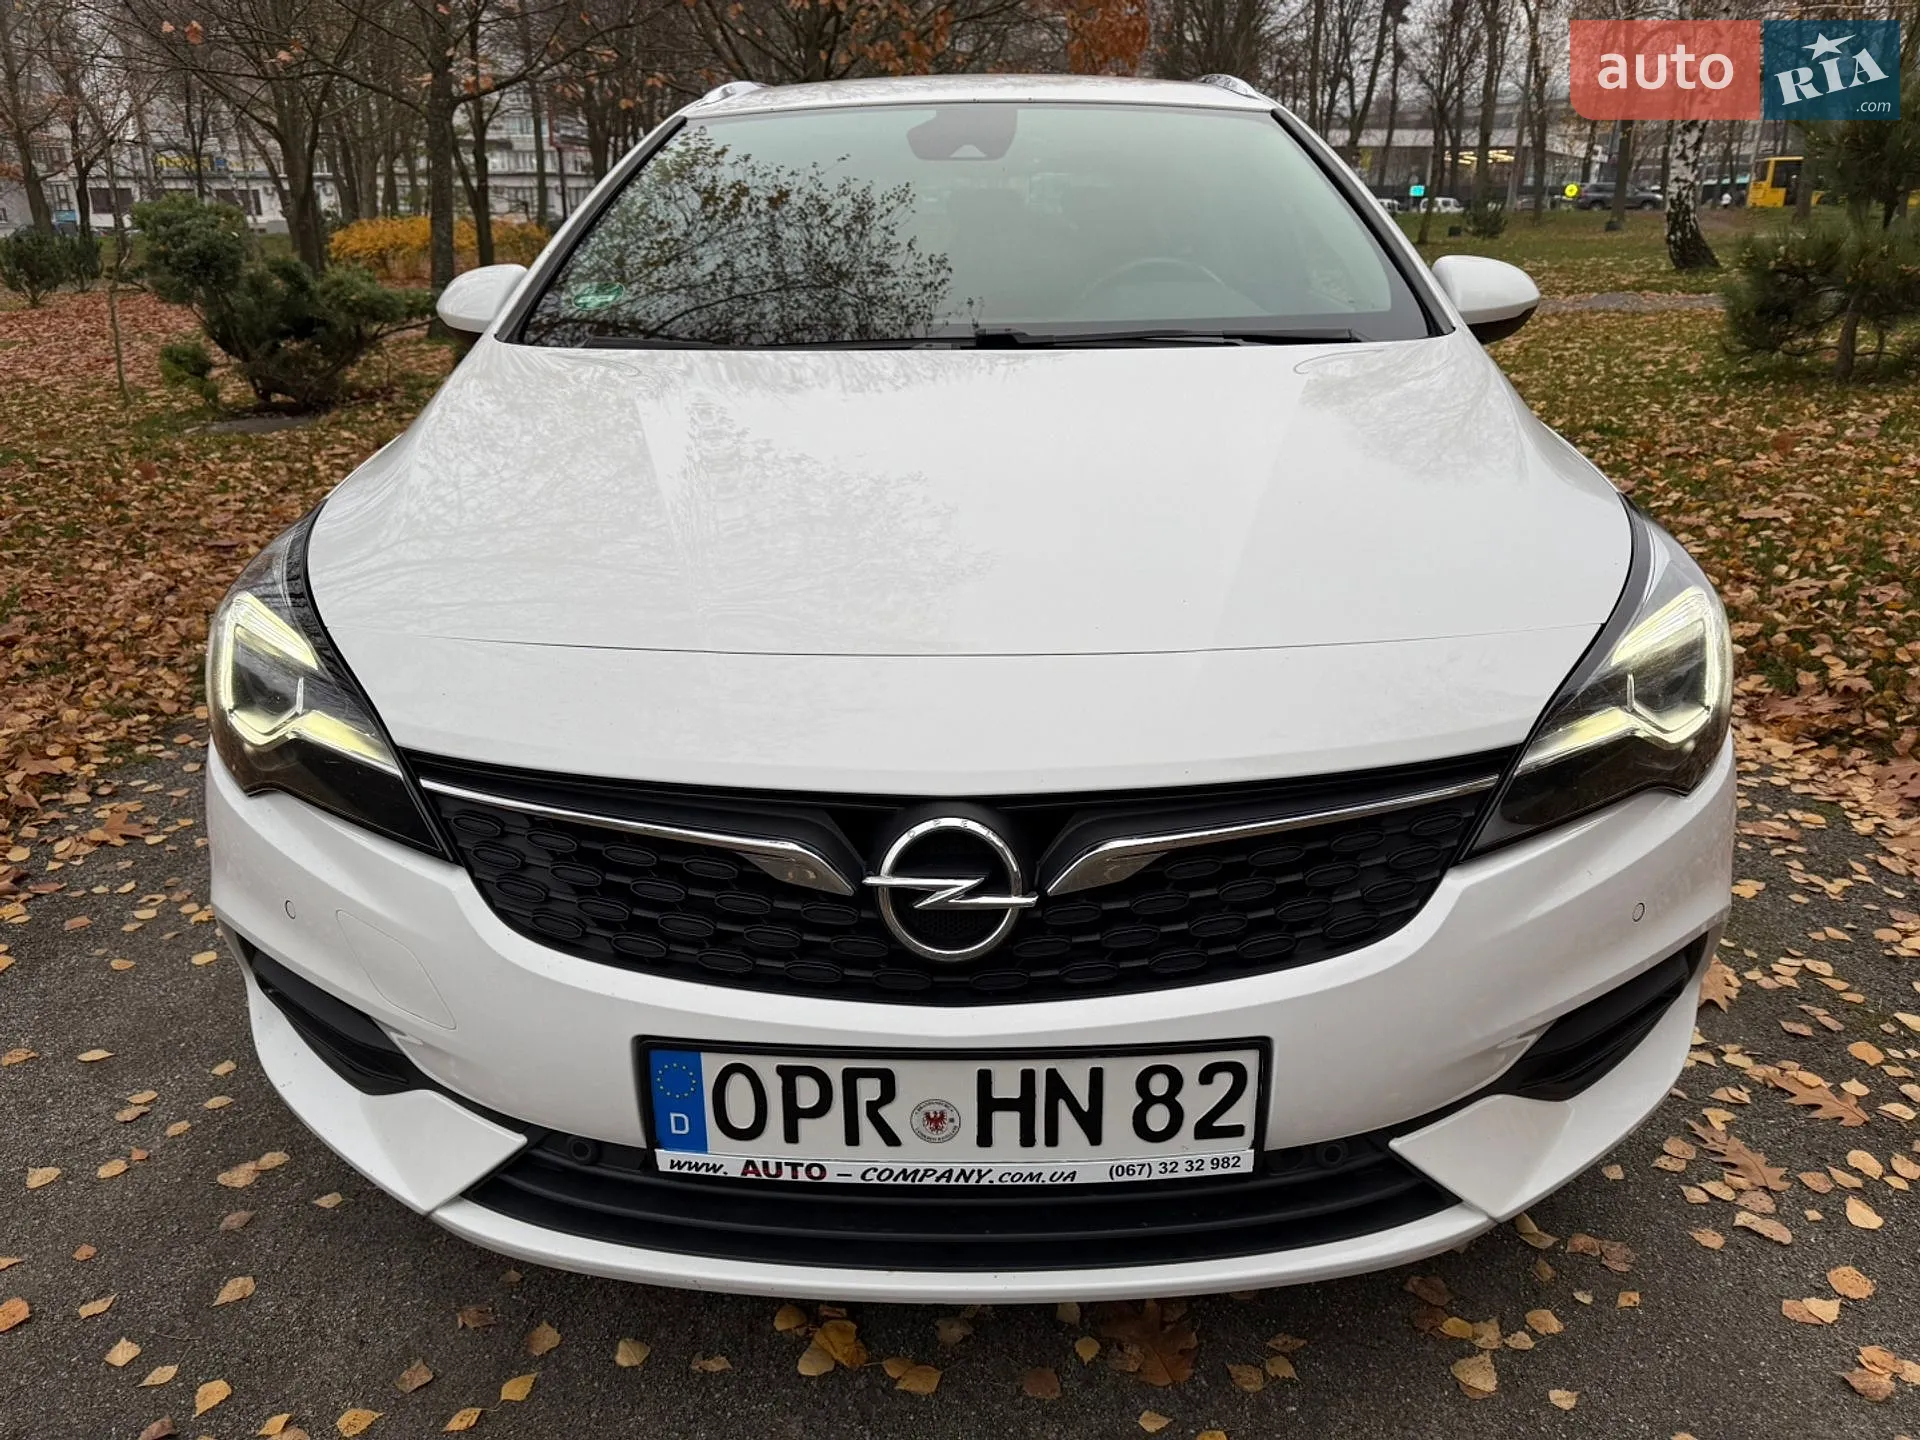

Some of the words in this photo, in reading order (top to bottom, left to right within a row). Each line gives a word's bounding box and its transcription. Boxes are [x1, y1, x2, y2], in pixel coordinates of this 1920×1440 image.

[712, 1062, 902, 1147] OPR
[976, 1066, 1104, 1148] HN
[1132, 1061, 1248, 1143] 82
[669, 1112, 690, 1135] D
[741, 1159, 828, 1181] AUTO
[1109, 1163, 1152, 1180] (067)
[1158, 1161, 1179, 1175] 32
[1184, 1158, 1205, 1172] 32
[1210, 1155, 1242, 1170] 982
